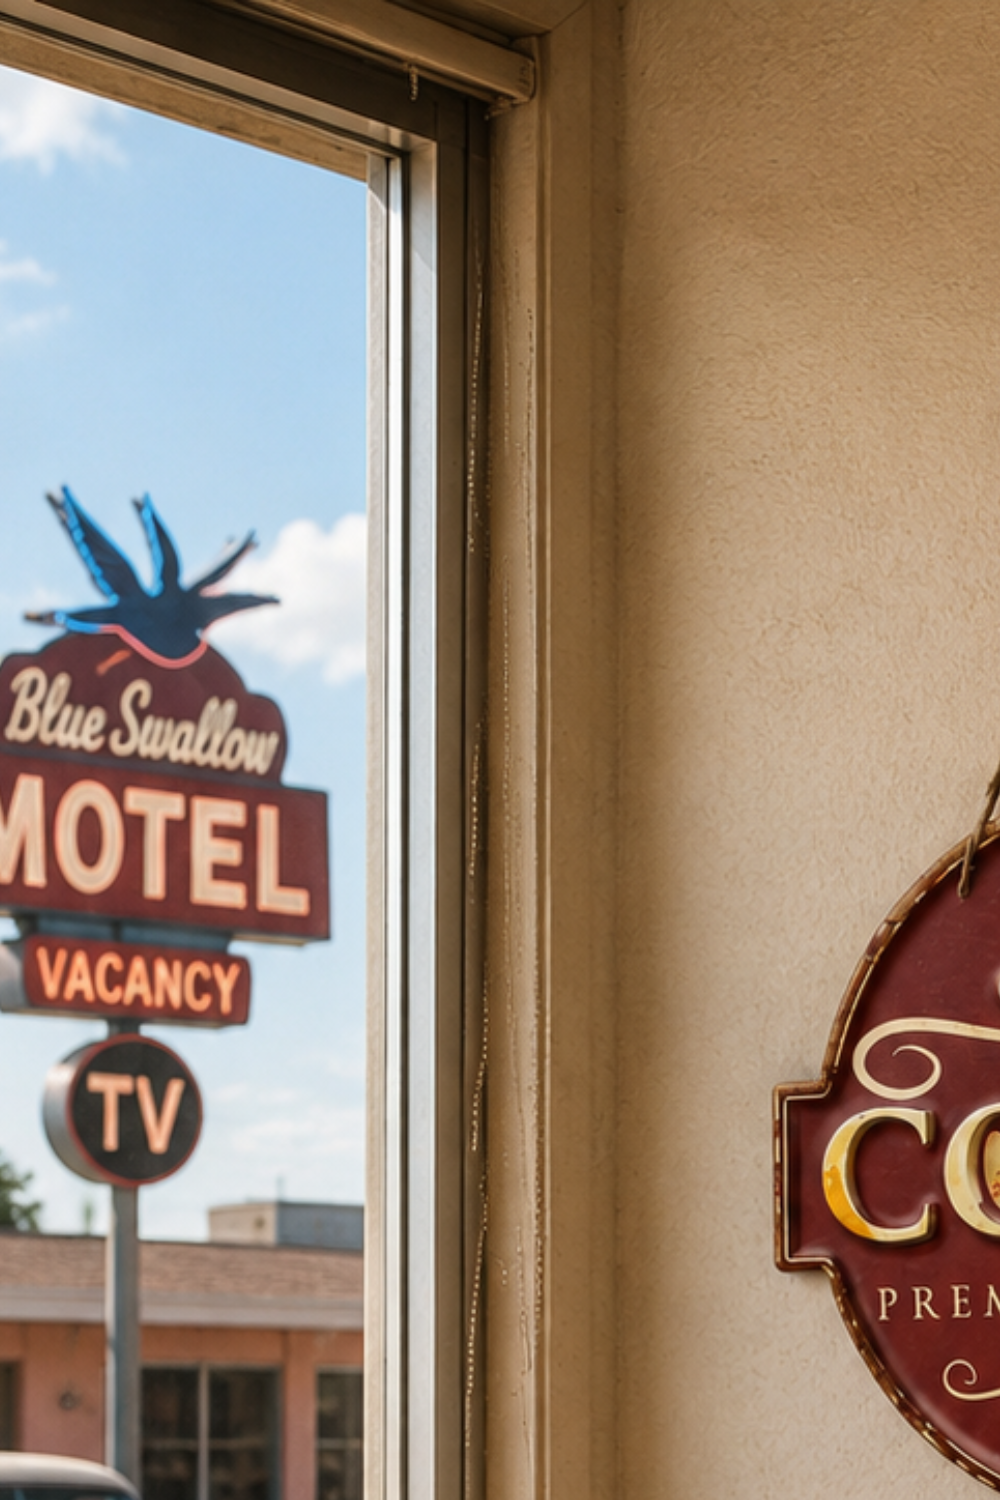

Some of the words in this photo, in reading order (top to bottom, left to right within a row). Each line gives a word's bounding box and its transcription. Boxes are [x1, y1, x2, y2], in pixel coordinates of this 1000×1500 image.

[5, 666, 107, 751] Blue
[109, 679, 280, 776] Swallow
[36, 946, 241, 1016] VACANCY
[86, 1071, 186, 1154] TV
